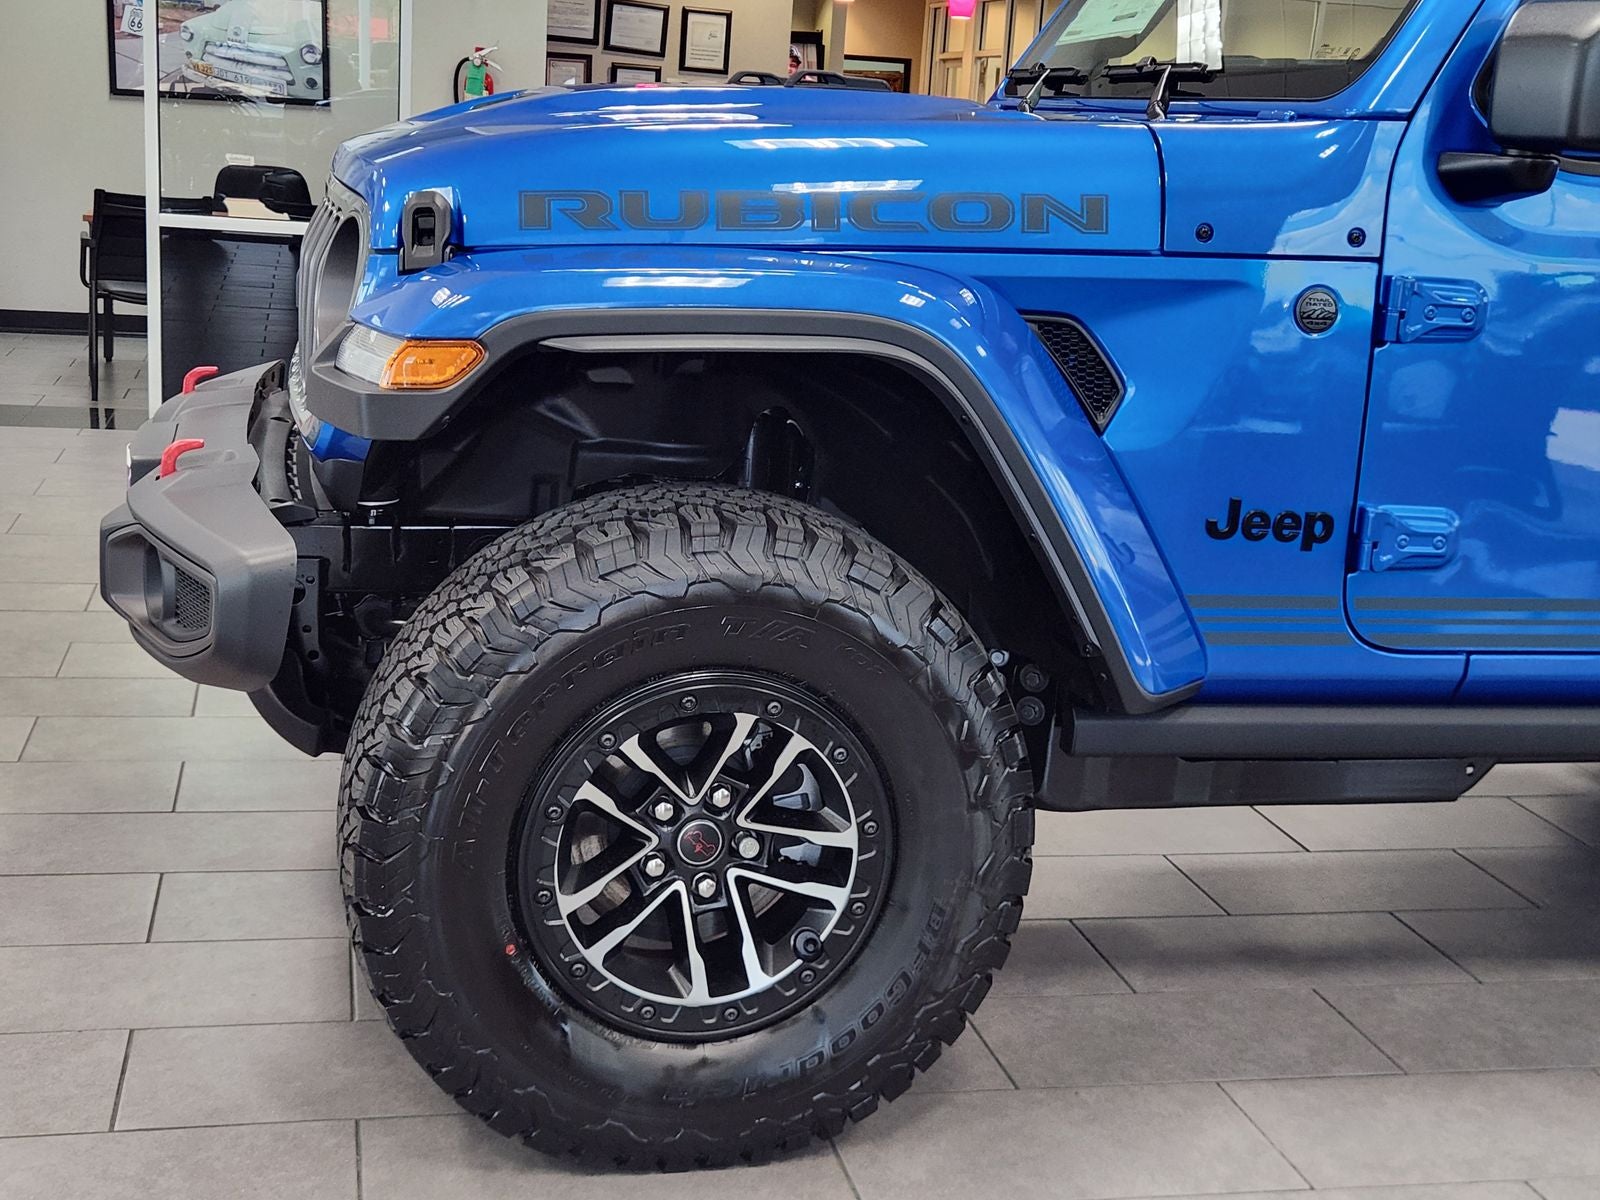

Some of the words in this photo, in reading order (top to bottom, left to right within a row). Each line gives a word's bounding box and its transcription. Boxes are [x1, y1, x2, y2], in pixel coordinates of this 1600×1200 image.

[130, 16, 143, 29] 66
[517, 189, 1110, 236] RUBICON
[1204, 497, 1335, 552] Jeep
